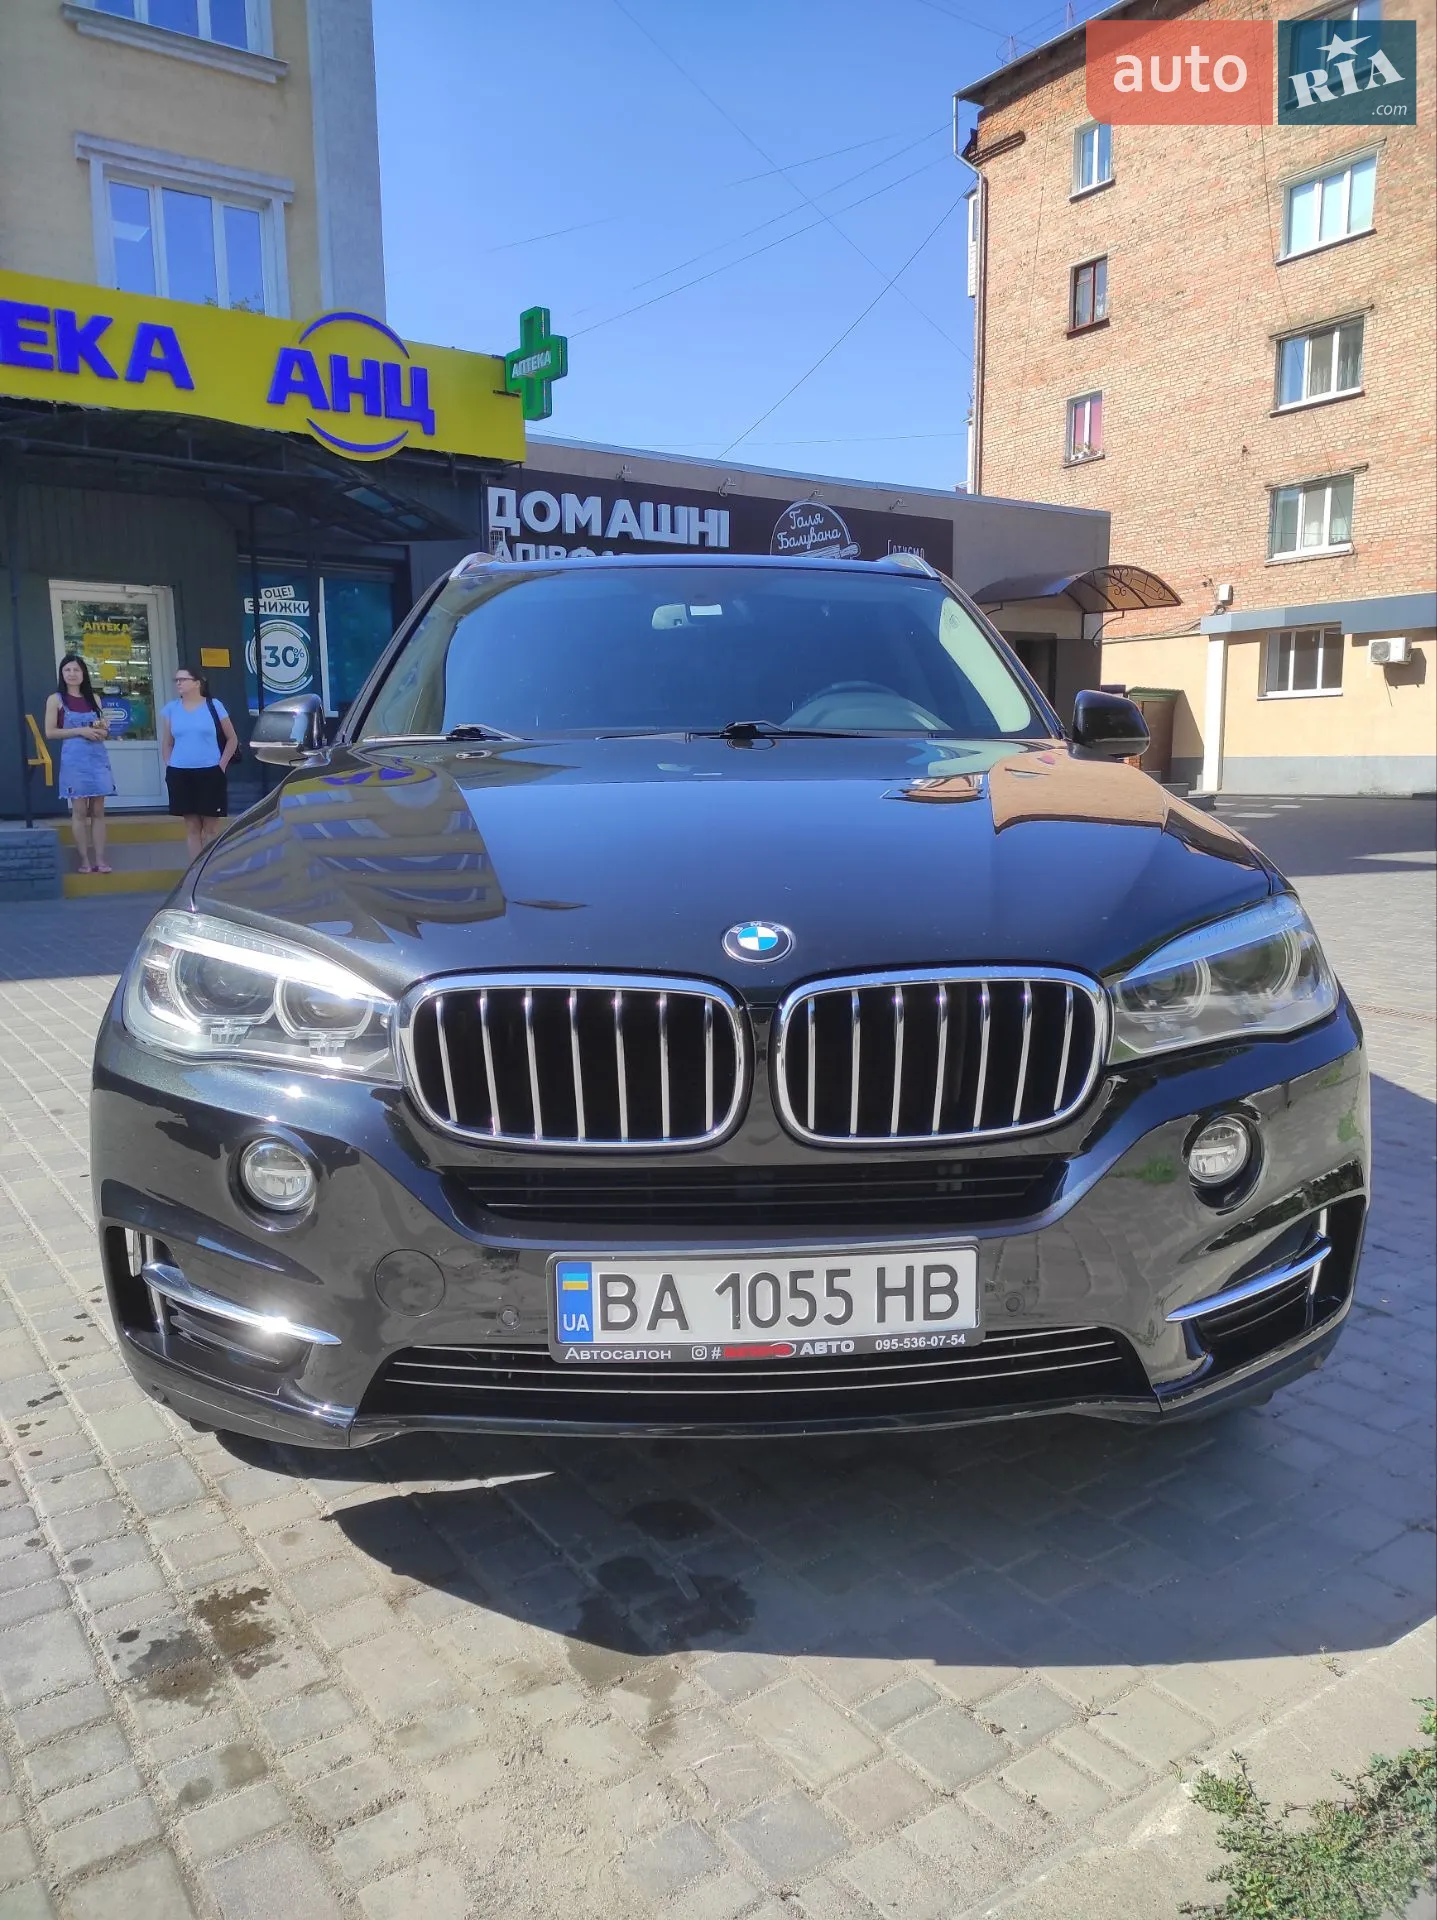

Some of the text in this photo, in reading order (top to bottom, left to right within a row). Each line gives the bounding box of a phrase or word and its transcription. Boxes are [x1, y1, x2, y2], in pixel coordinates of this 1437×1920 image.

[511, 350, 552, 379] АПТЕКА
[266, 345, 436, 436] АНЦ
[487, 486, 731, 550] ДОМАШНІ
[789, 508, 825, 530] Галя
[776, 528, 842, 551] Балувана
[83, 622, 130, 632] АПТЕКА
[714, 1269, 853, 1330] 1055
[562, 1313, 590, 1332] UA
[564, 1346, 672, 1361] Автосалон
[800, 1340, 855, 1355] АВТО
[875, 1333, 966, 1351] 095-536-07-54
